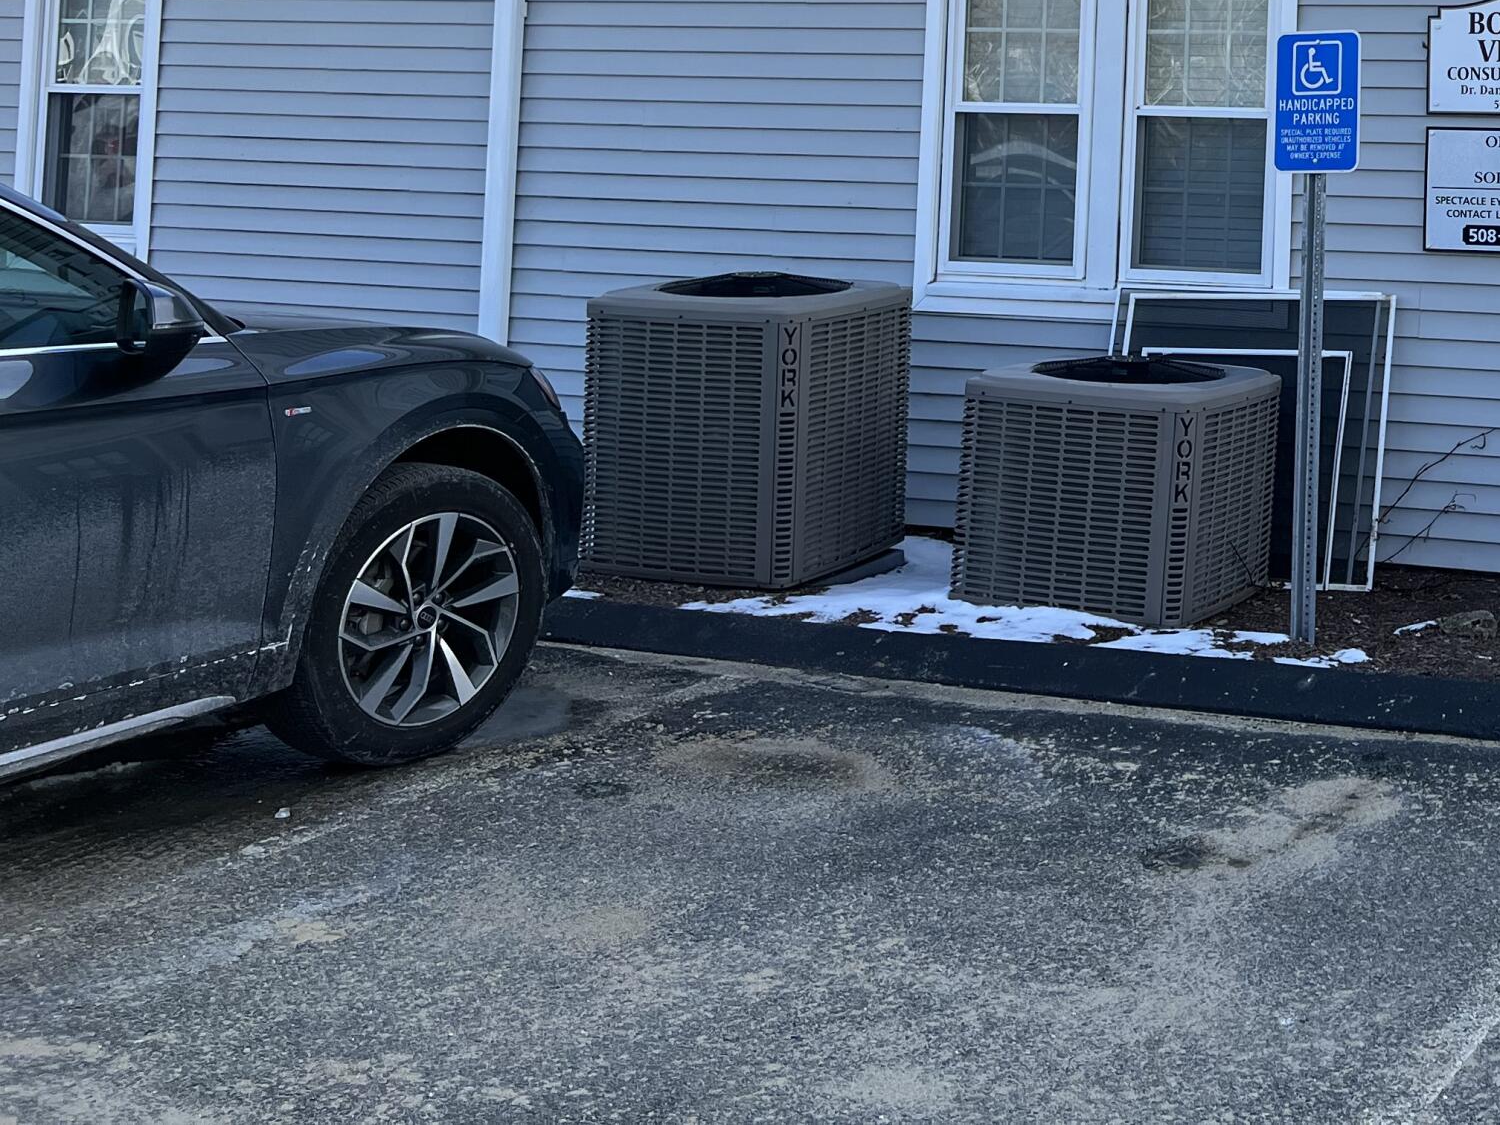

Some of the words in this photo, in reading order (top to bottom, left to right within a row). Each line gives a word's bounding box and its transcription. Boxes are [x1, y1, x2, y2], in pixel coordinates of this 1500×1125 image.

[1460, 84, 1477, 95] Dr.
[1279, 98, 1354, 111] HANDICAPPED
[1293, 113, 1340, 125] PARKING
[1435, 196, 1486, 206] SPECTACLE
[1446, 209, 1492, 219] CONTACT
[781, 326, 797, 408] YORK
[1174, 417, 1194, 503] YORK
